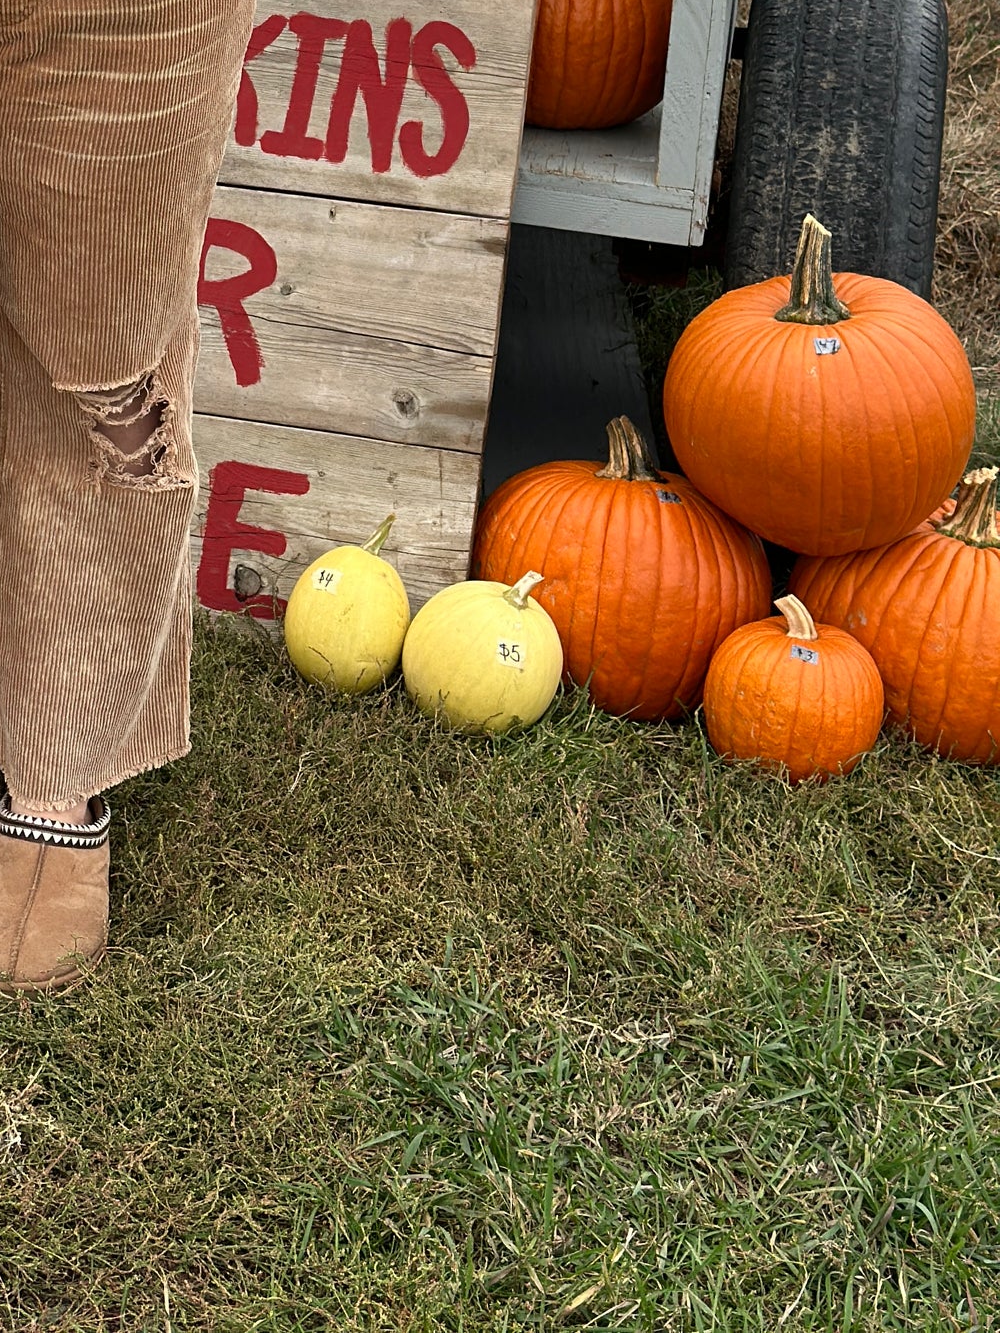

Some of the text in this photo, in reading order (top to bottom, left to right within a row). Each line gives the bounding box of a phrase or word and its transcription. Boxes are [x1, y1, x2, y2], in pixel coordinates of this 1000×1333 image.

[196, 461, 310, 619] E
[317, 570, 334, 588] $4
[499, 643, 520, 663] $5
